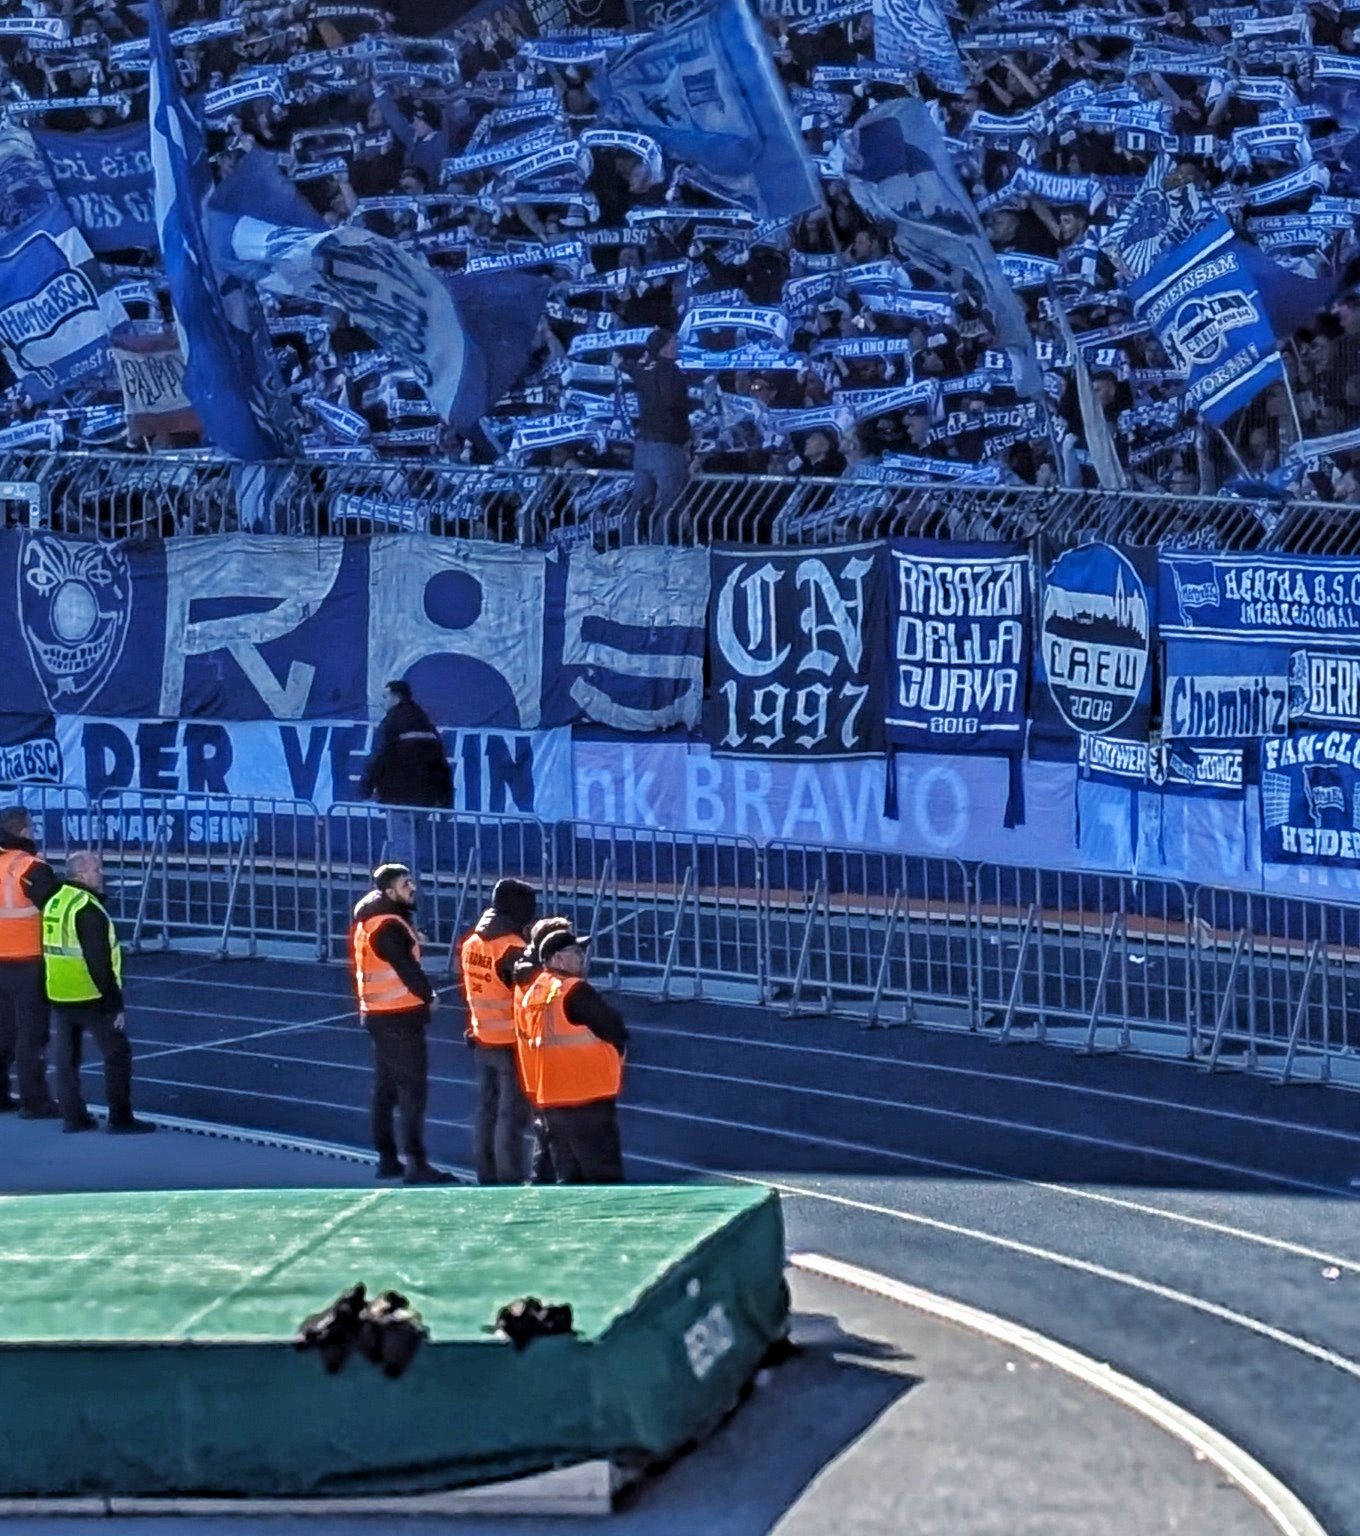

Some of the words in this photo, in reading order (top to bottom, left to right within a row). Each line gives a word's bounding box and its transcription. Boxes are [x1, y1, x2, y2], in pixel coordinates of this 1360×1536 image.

[899, 564, 1021, 616] RAGAZZI
[1225, 568, 1310, 604] HERTHA
[896, 620, 1021, 664] DELLA
[720, 682, 869, 748] 1997
[899, 667, 1017, 713] CURVA
[1069, 696, 1112, 722] 2008
[1170, 674, 1286, 736] Chemnitz
[81, 721, 233, 800] DER
[280, 724, 534, 813] VEIN
[685, 759, 969, 848] BRAWO
